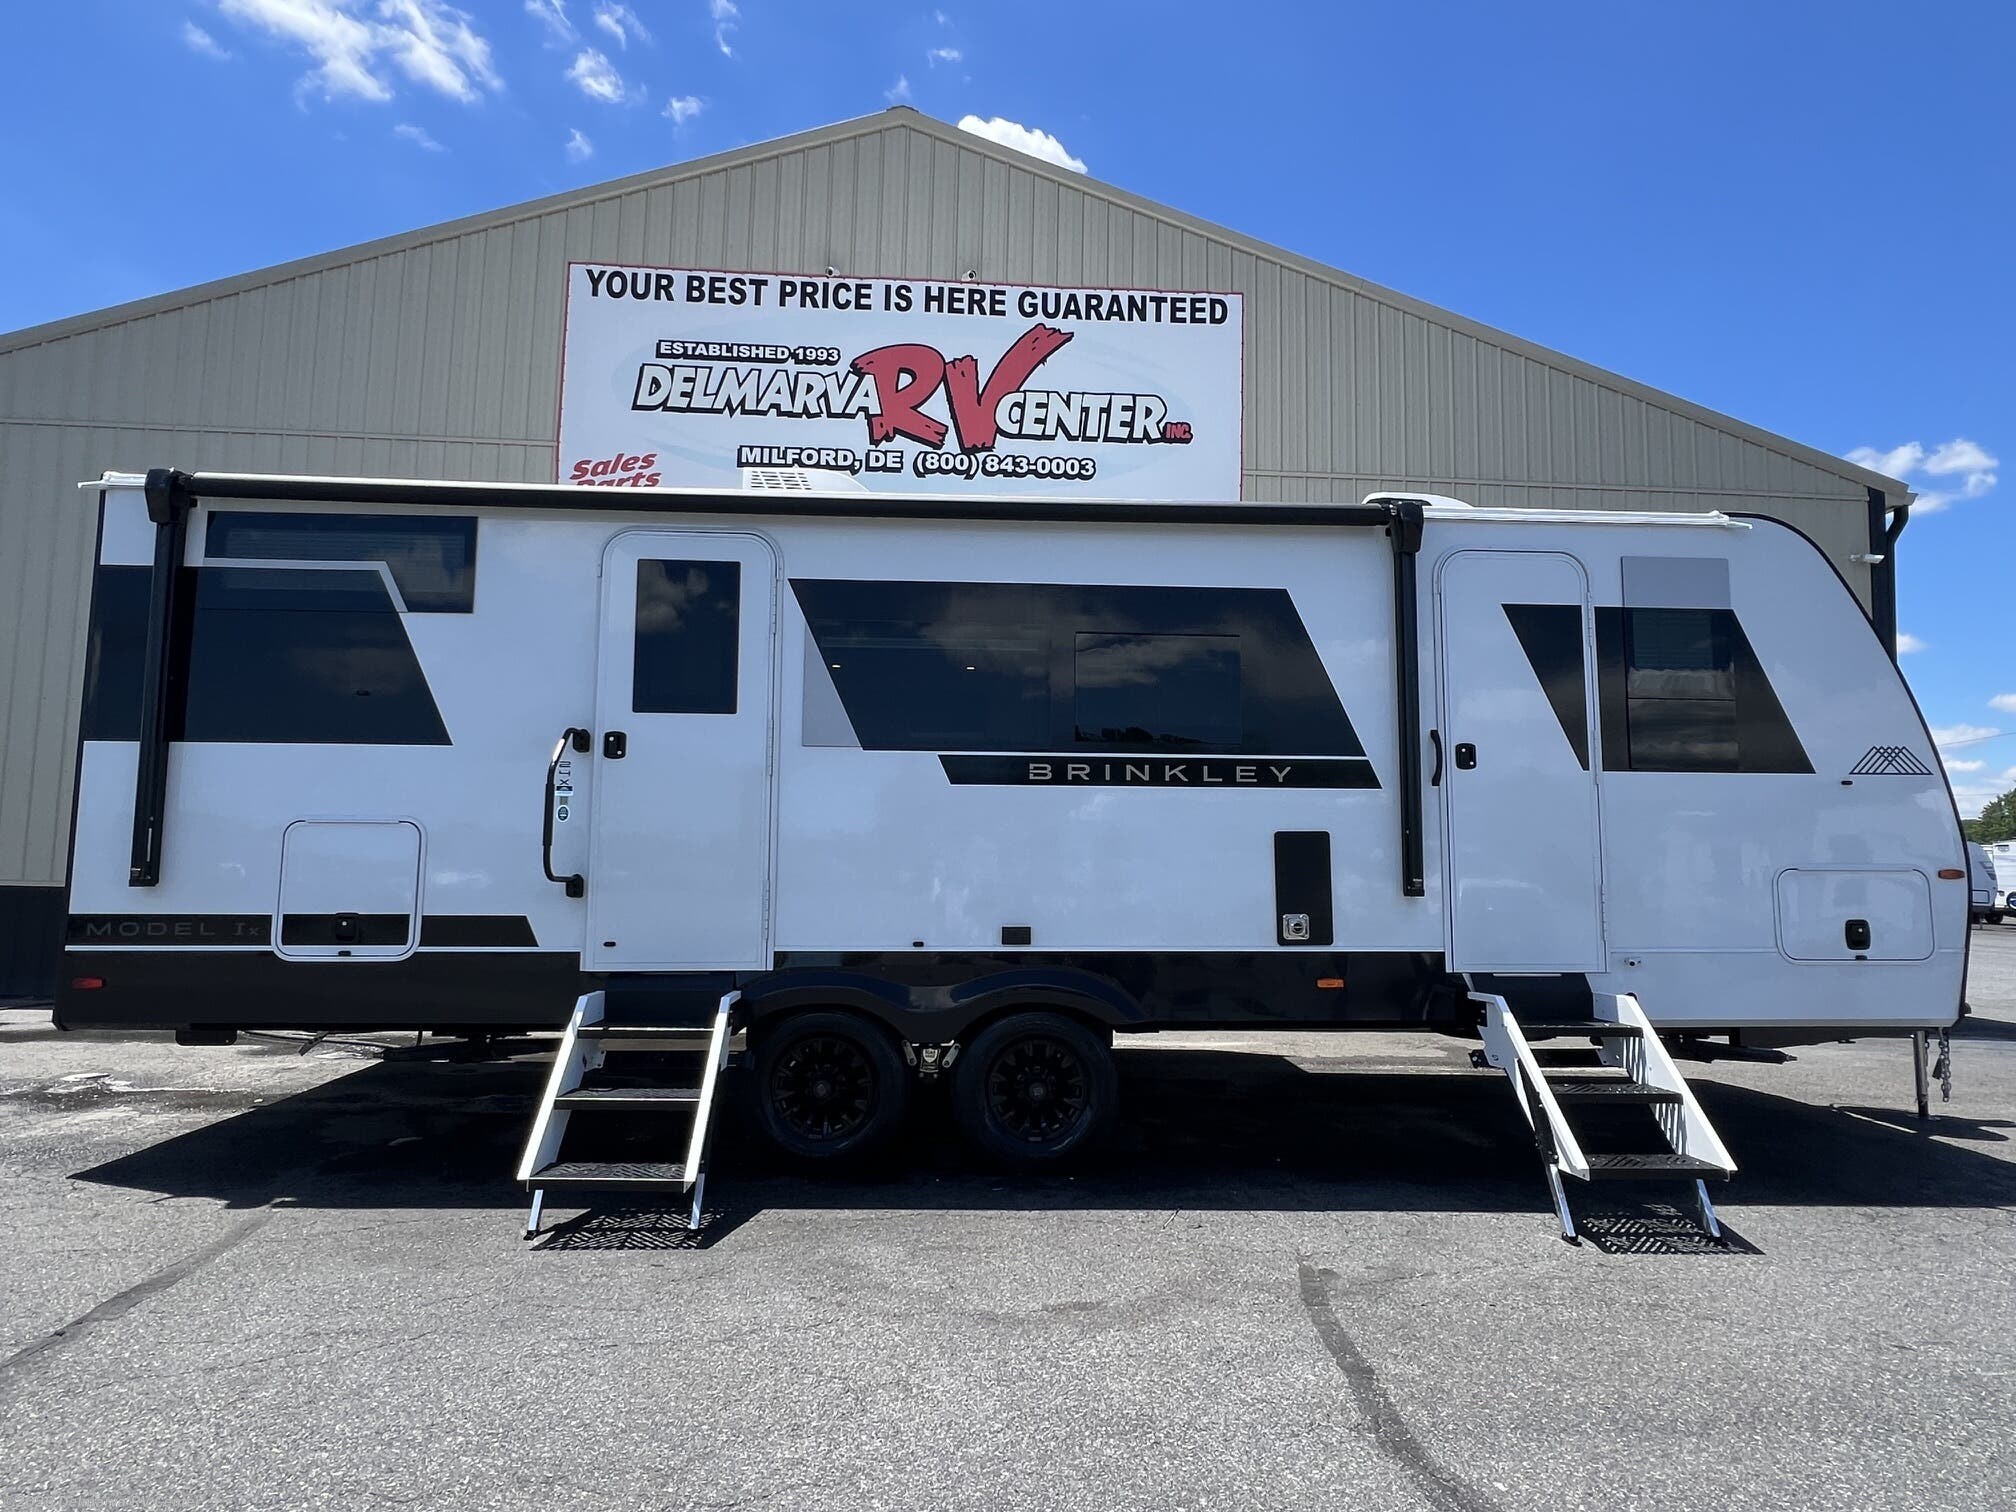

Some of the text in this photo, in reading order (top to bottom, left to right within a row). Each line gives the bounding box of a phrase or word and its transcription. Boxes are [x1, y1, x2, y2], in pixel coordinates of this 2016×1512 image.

[585, 268, 1228, 325] YOUR BEST PRICE IS HERE GUARANTEED
[657, 340, 840, 365] ESTABLISHED 1993
[631, 363, 882, 418] DELMARVA
[850, 322, 1074, 454] RV
[994, 390, 1167, 444] CENTER
[569, 453, 658, 479] Sales
[738, 445, 1097, 479] MILFORD, DE (800) 843-0003
[1028, 763, 1292, 783] BRINKLEY
[86, 921, 217, 937] MODEL
